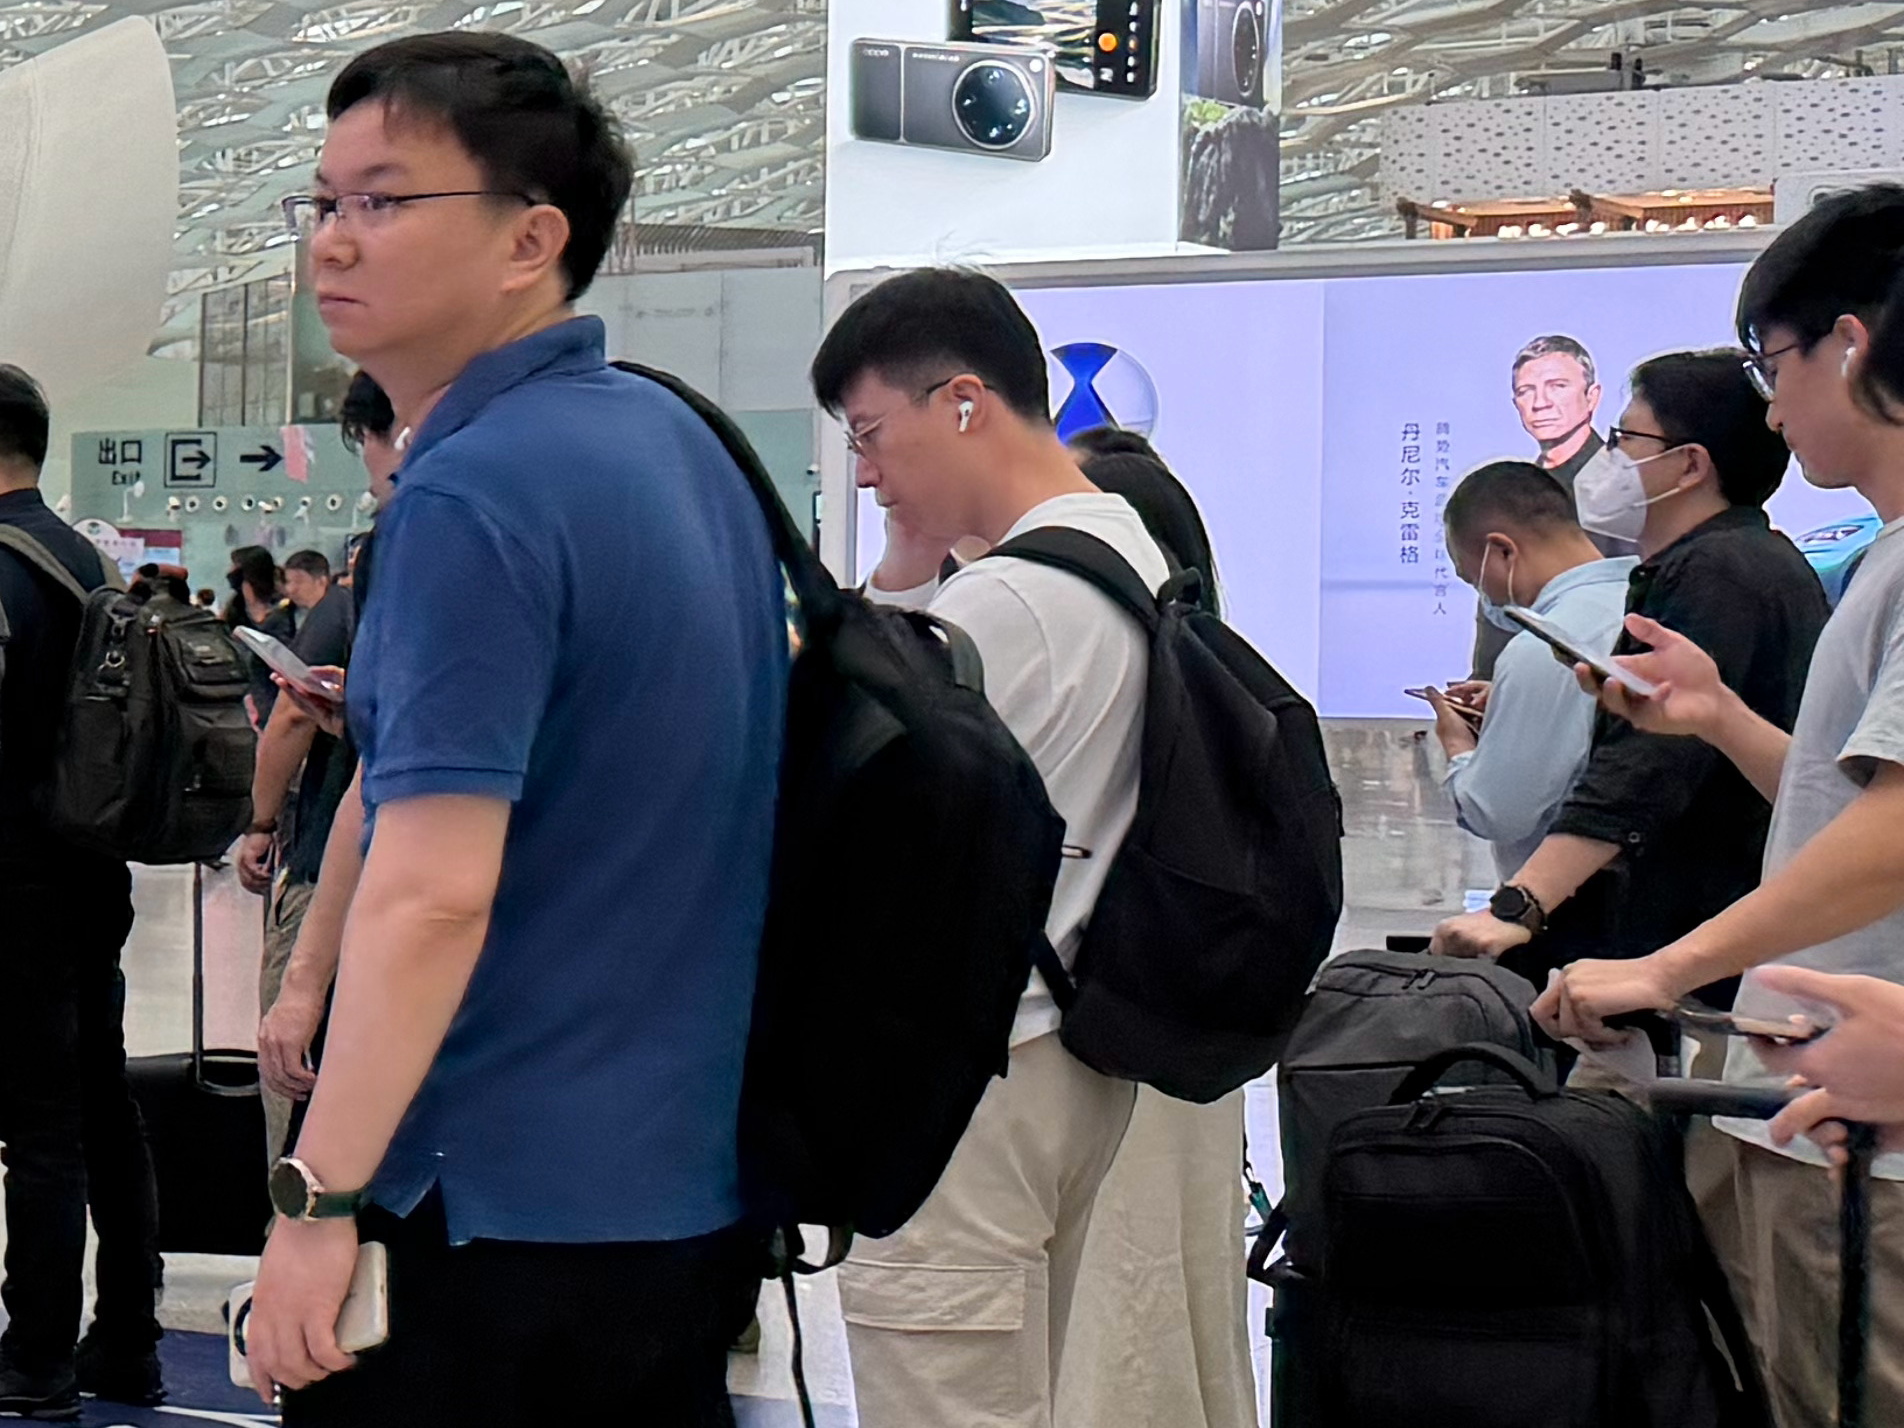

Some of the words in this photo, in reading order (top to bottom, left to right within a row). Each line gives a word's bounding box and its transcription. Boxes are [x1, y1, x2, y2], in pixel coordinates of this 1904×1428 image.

[98, 437, 143, 465] 出口
[1399, 422, 1421, 565] 丹尼尔·克雷格
